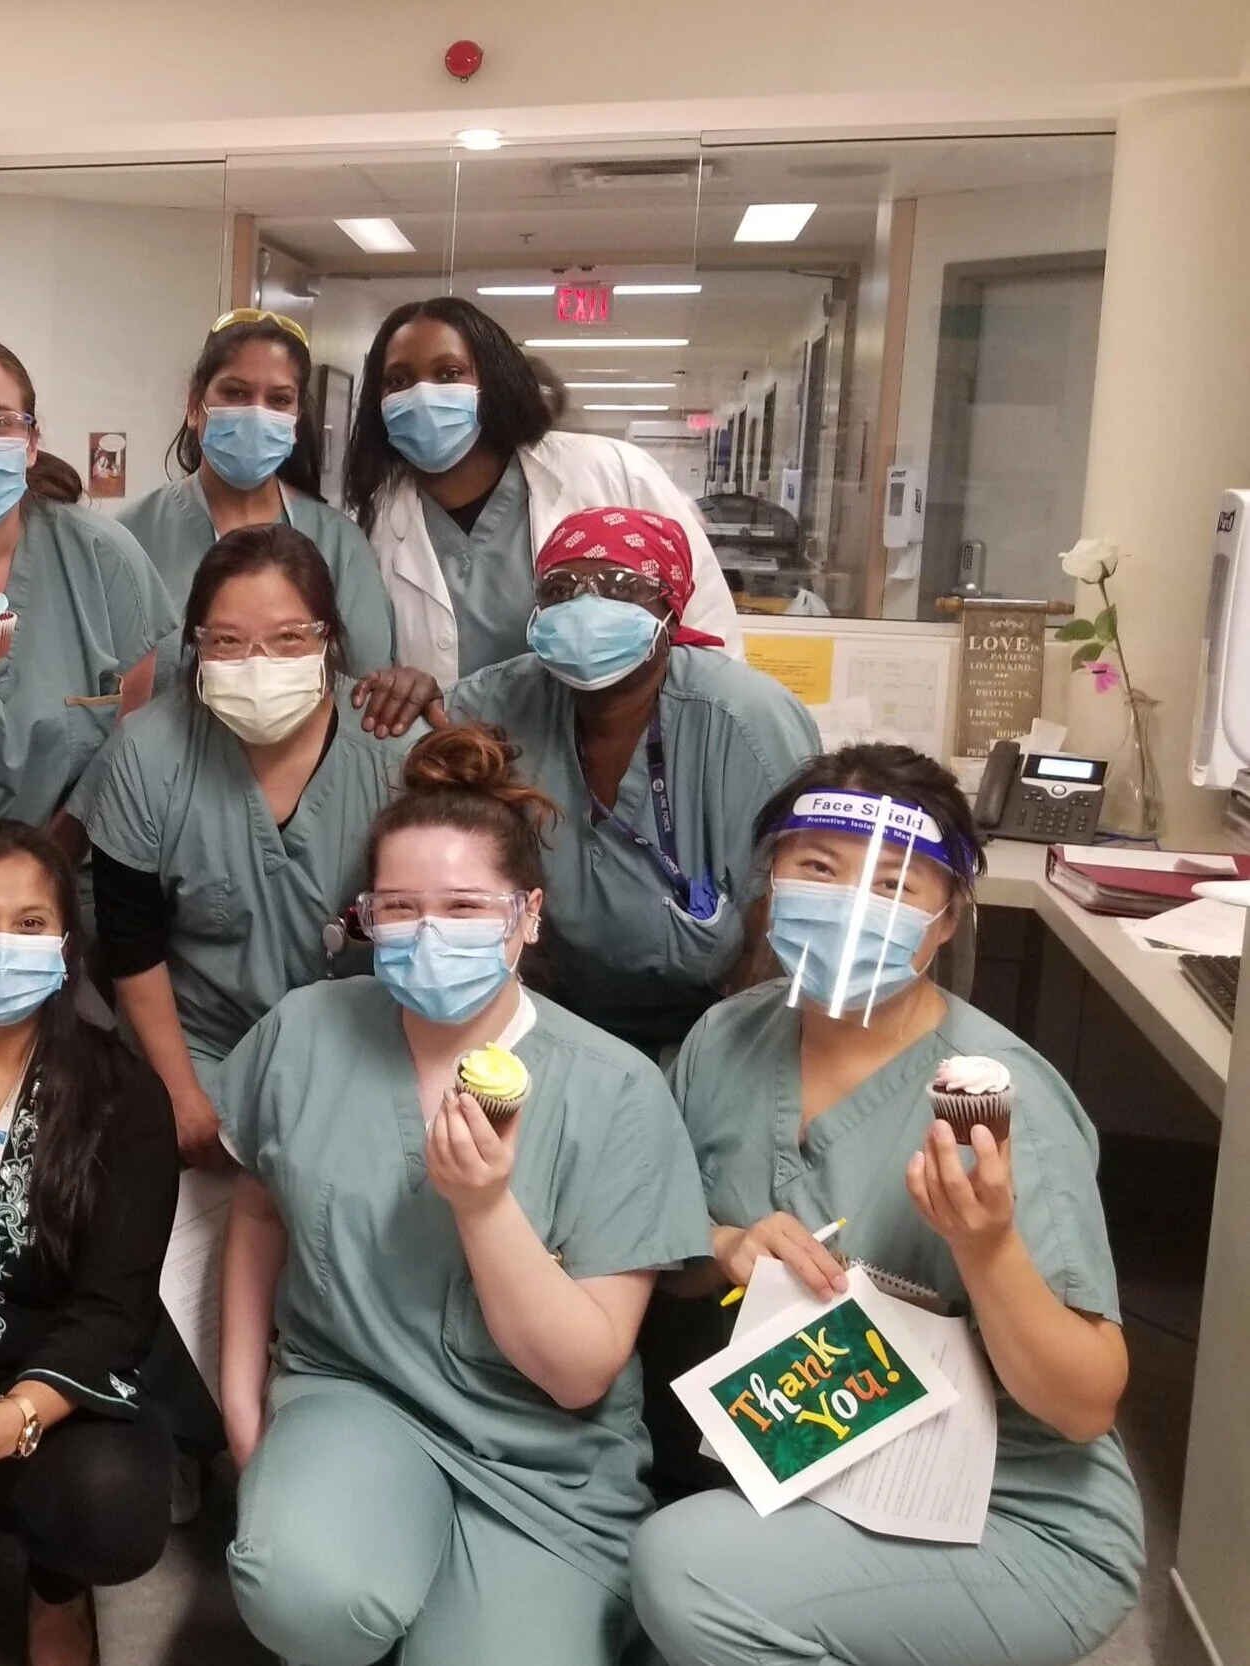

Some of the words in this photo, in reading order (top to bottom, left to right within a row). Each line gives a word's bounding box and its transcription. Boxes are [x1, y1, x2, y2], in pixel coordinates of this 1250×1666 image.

[968, 635, 1029, 652] LOVE
[990, 652, 1033, 662] PATIENT
[970, 662, 995, 670] LOVE
[996, 663, 1007, 671] IS
[812, 798, 853, 813] Face
[806, 815, 847, 826] Protective
[893, 830, 914, 842] Mas
[727, 1326, 851, 1433] Thank
